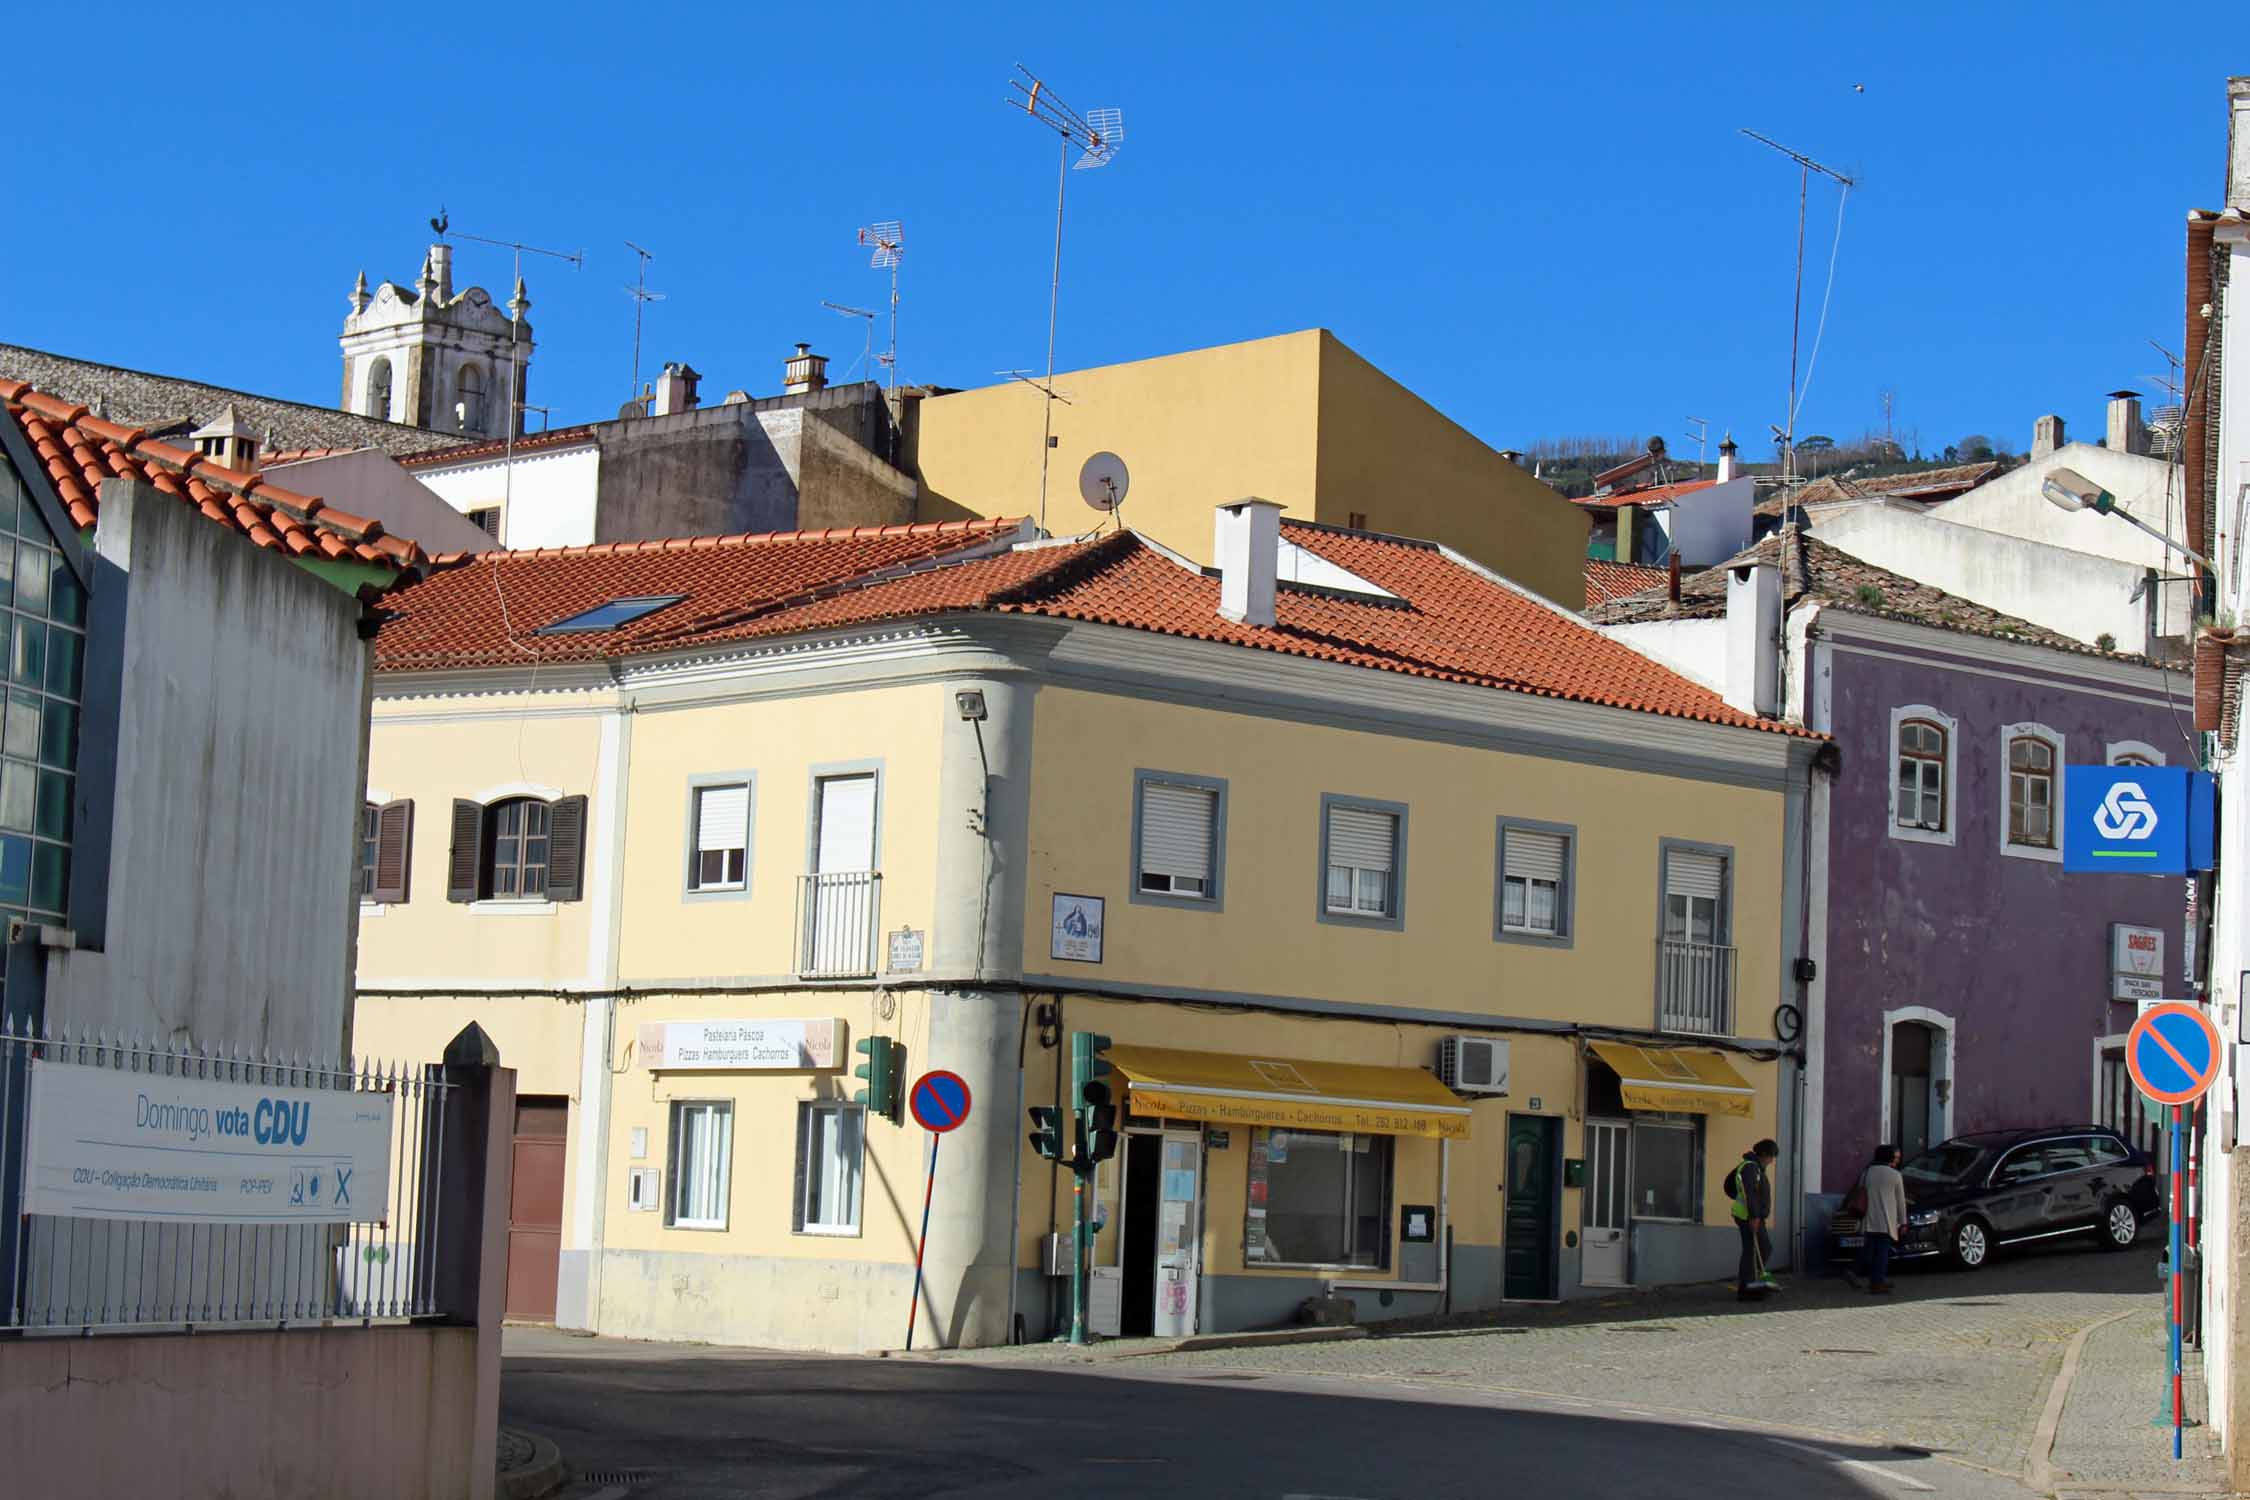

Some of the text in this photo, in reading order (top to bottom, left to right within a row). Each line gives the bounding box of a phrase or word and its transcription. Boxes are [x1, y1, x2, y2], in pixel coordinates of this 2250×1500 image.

[2127, 933, 2157, 952] SAGRES
[805, 1037, 832, 1052] Nicola
[1134, 1094, 1167, 1112] Nicola
[136, 1094, 310, 1147] Domingo, vota CDU
[73, 1167, 95, 1185] CDU
